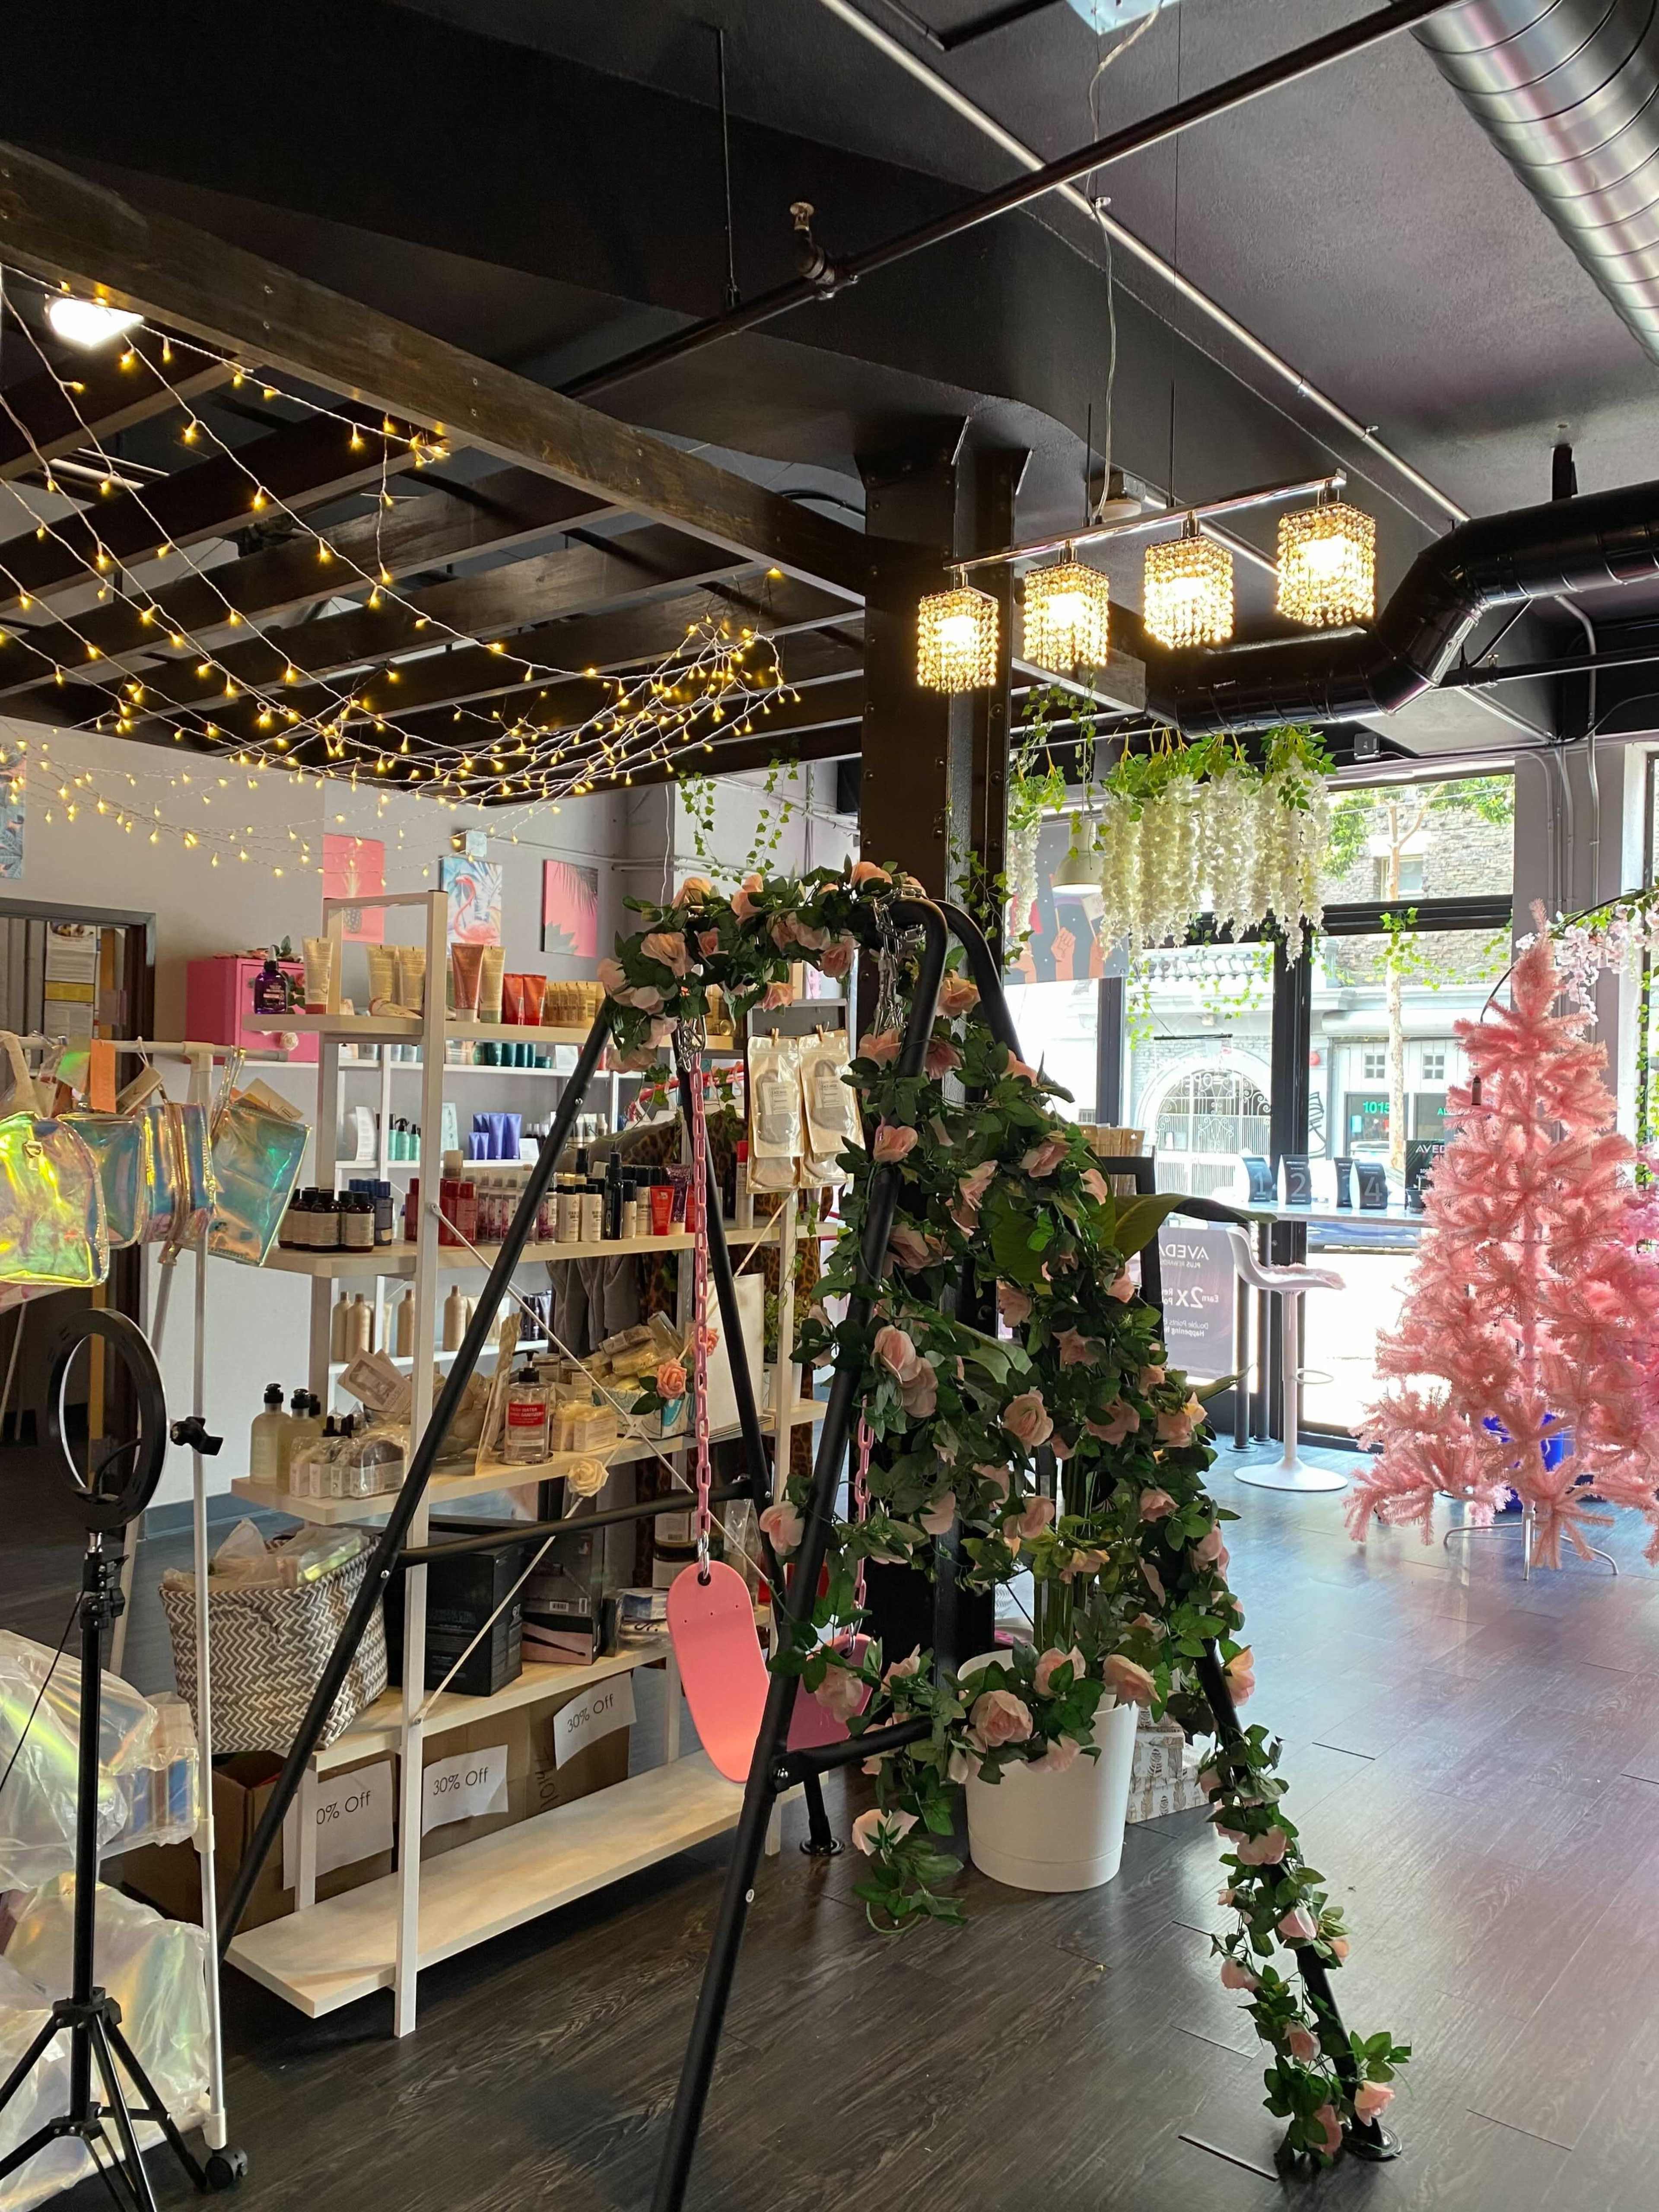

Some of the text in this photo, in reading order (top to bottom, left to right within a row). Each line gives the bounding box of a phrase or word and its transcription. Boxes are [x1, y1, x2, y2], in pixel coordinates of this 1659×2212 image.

[1363, 1101, 1389, 1114] 1015
[1415, 1144, 1445, 1153] AVED
[1254, 1172, 1266, 1195] 1
[1290, 1172, 1306, 1197] 2
[1364, 1176, 1383, 1202] 4
[567, 1694, 614, 1732] 30% Off
[433, 1766, 489, 1796] 30% Off
[316, 1790, 371, 1824] 0% Off
